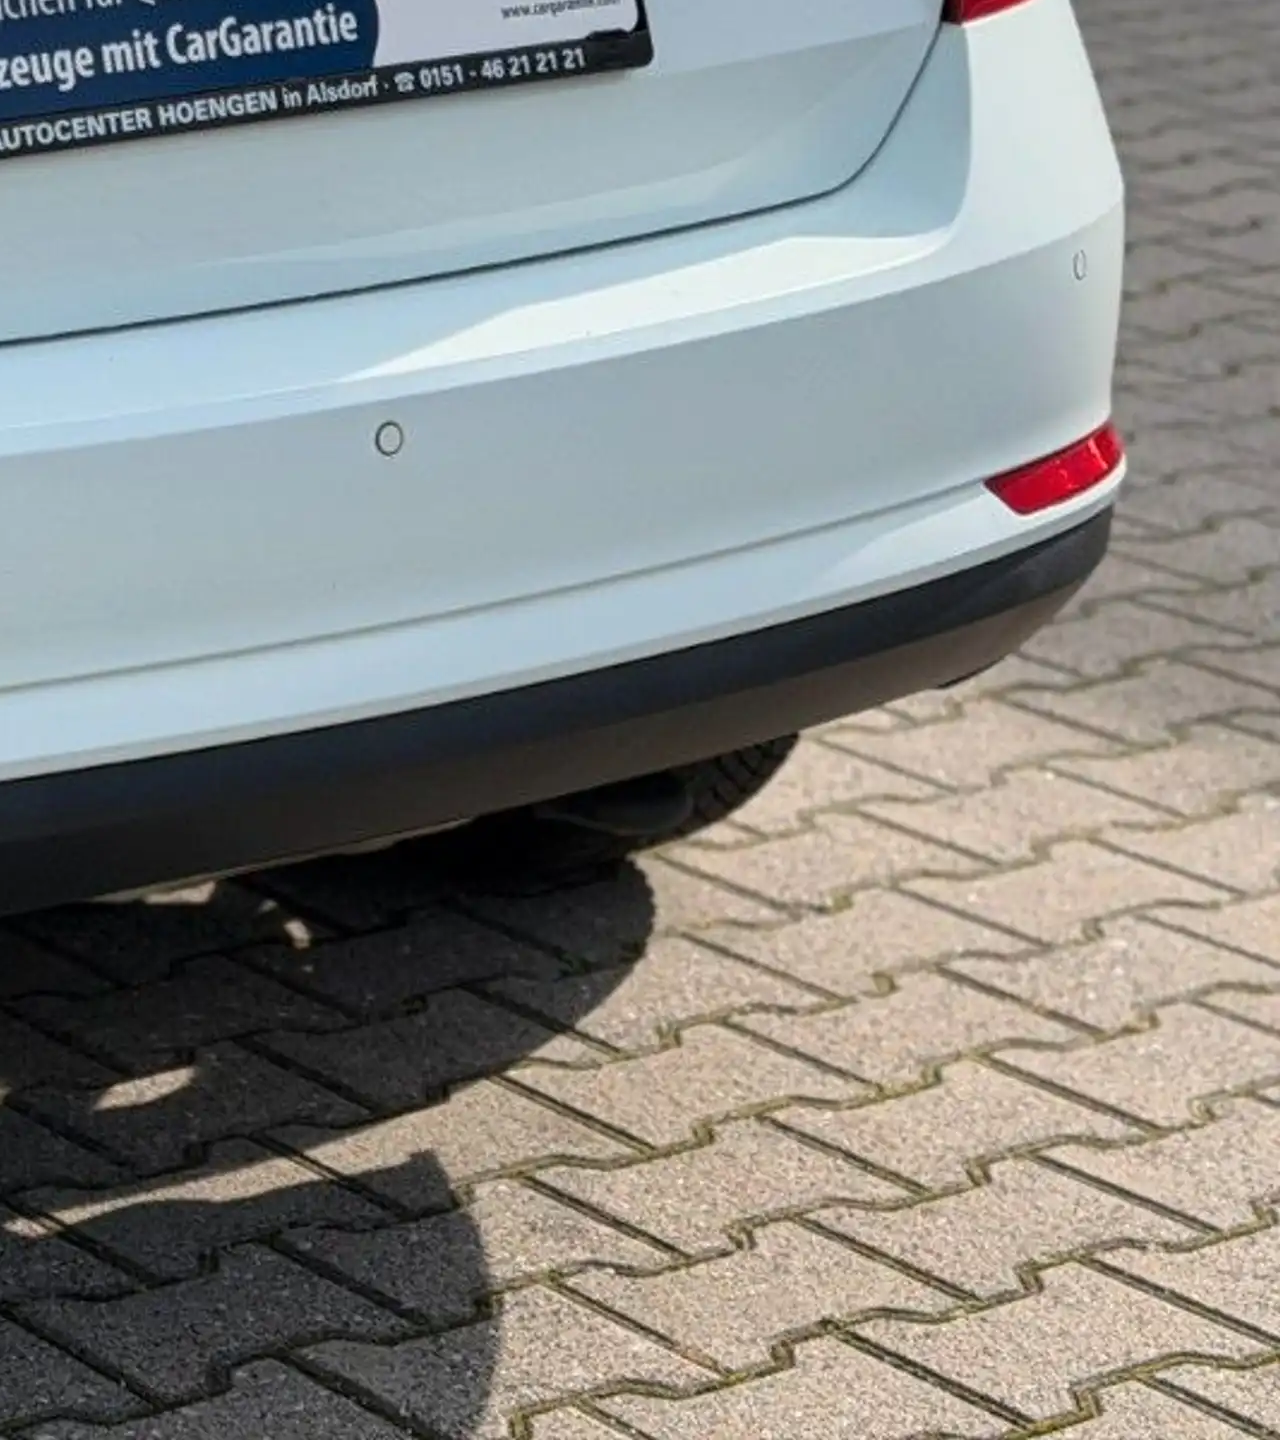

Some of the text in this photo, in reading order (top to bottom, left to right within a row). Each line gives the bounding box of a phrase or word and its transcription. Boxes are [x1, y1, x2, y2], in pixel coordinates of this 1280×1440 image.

[101, 29, 162, 75] mit
[166, 2, 359, 65] CarGarantie
[157, 88, 278, 128] HOENGEN
[282, 85, 302, 109] in
[307, 73, 378, 106] Alsdorf
[420, 64, 464, 89] 0151
[480, 59, 504, 80] 46
[509, 55, 531, 78] 21
[536, 51, 558, 73] 21
[562, 47, 586, 69] 21
